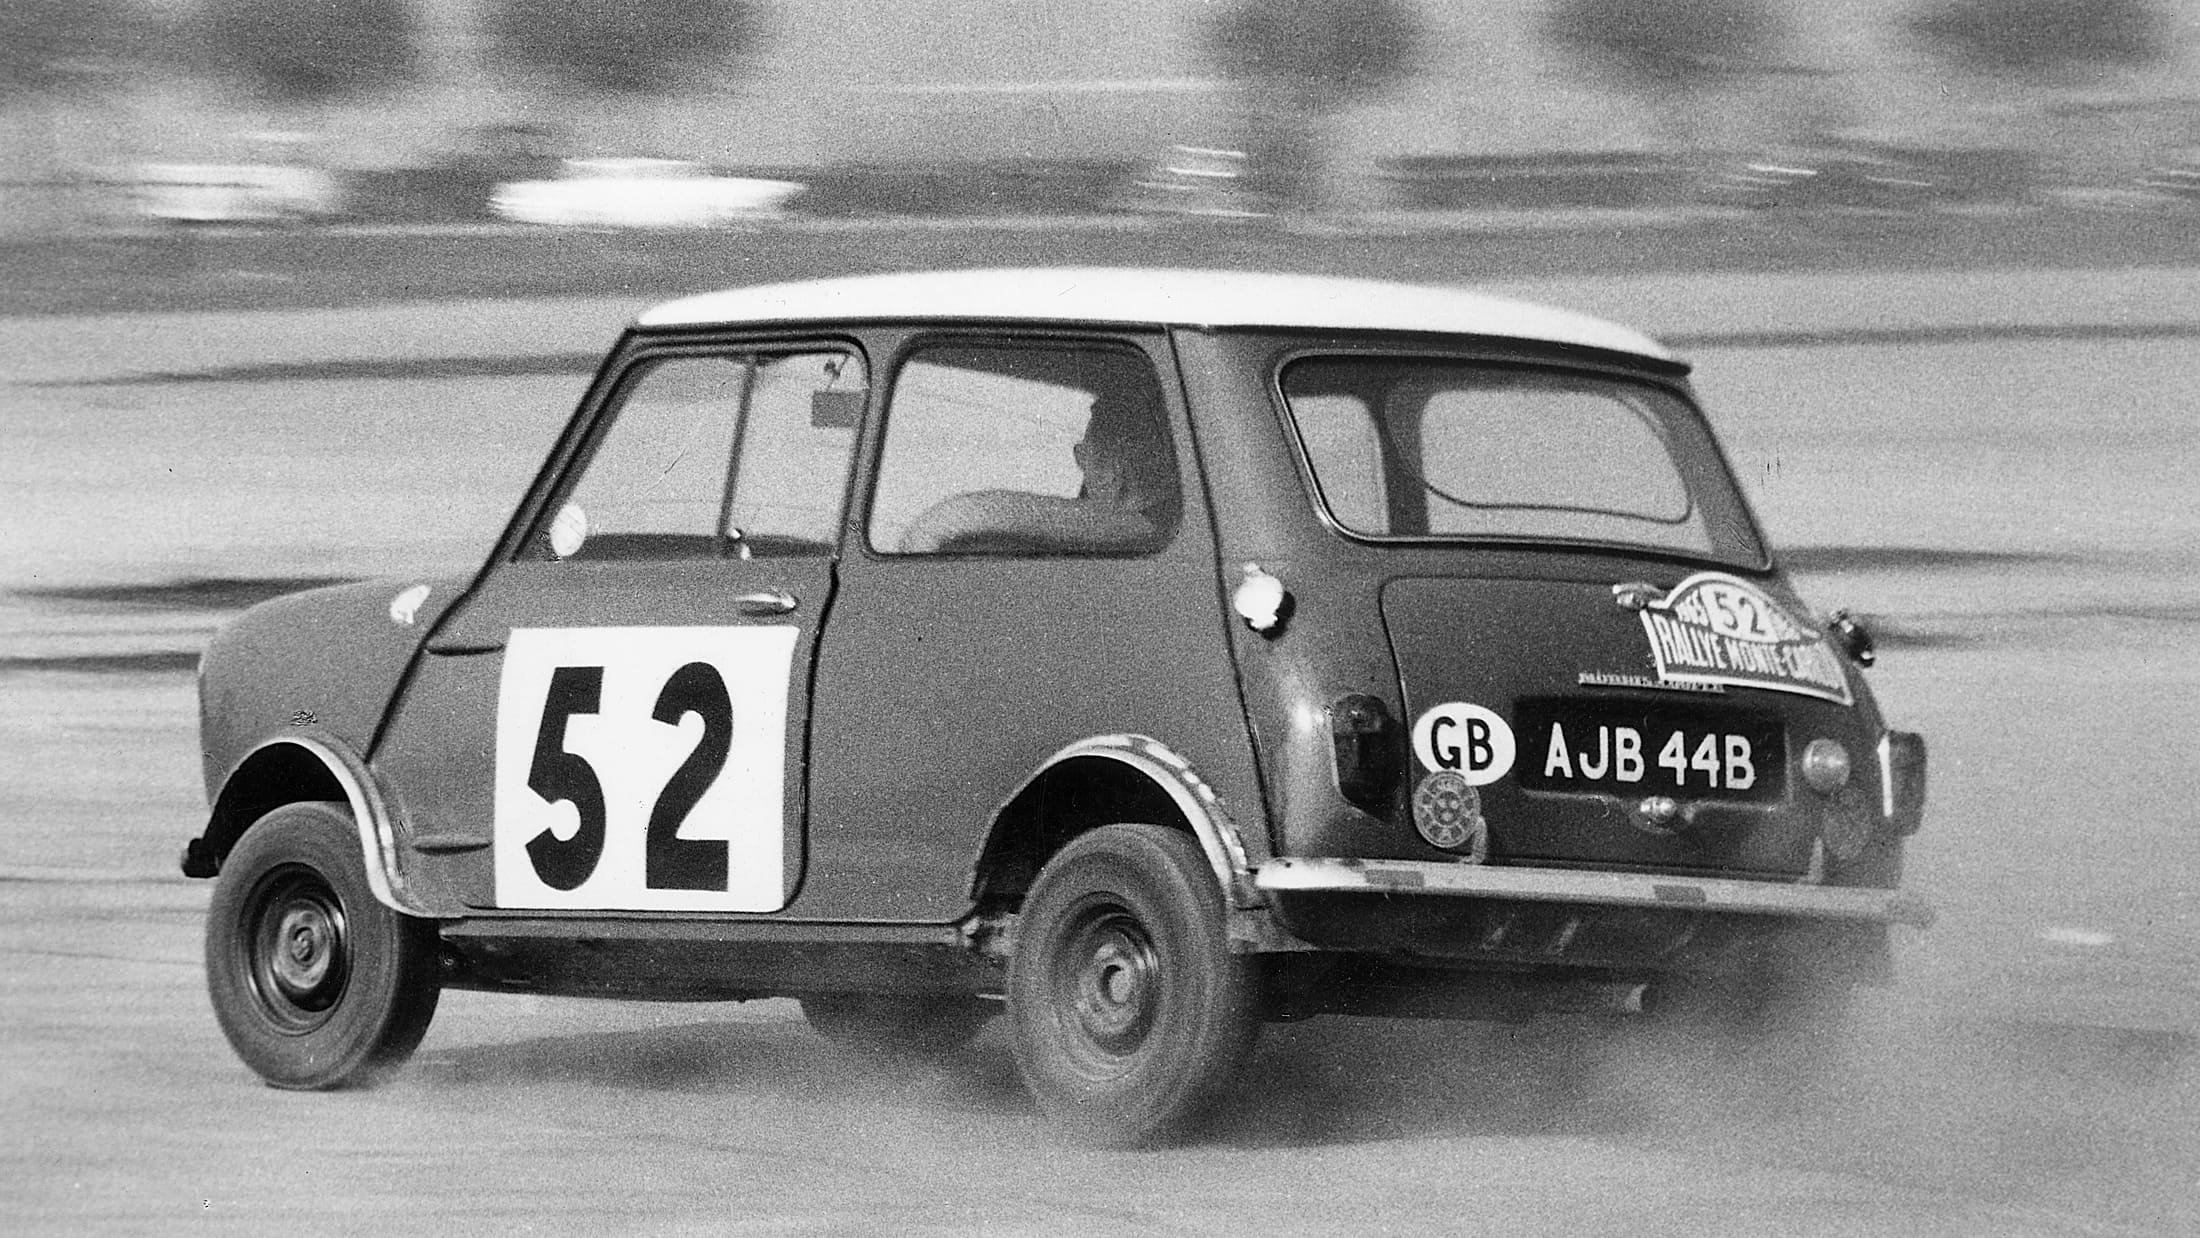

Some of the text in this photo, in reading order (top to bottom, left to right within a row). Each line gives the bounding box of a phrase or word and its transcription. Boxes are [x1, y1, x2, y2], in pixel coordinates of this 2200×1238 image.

[1652, 612, 1728, 670] RALLYE
[1713, 590, 1766, 635] 52
[1430, 715, 1495, 772] GB
[1544, 721, 1758, 791] AJB 44B
[524, 660, 734, 893] 52
